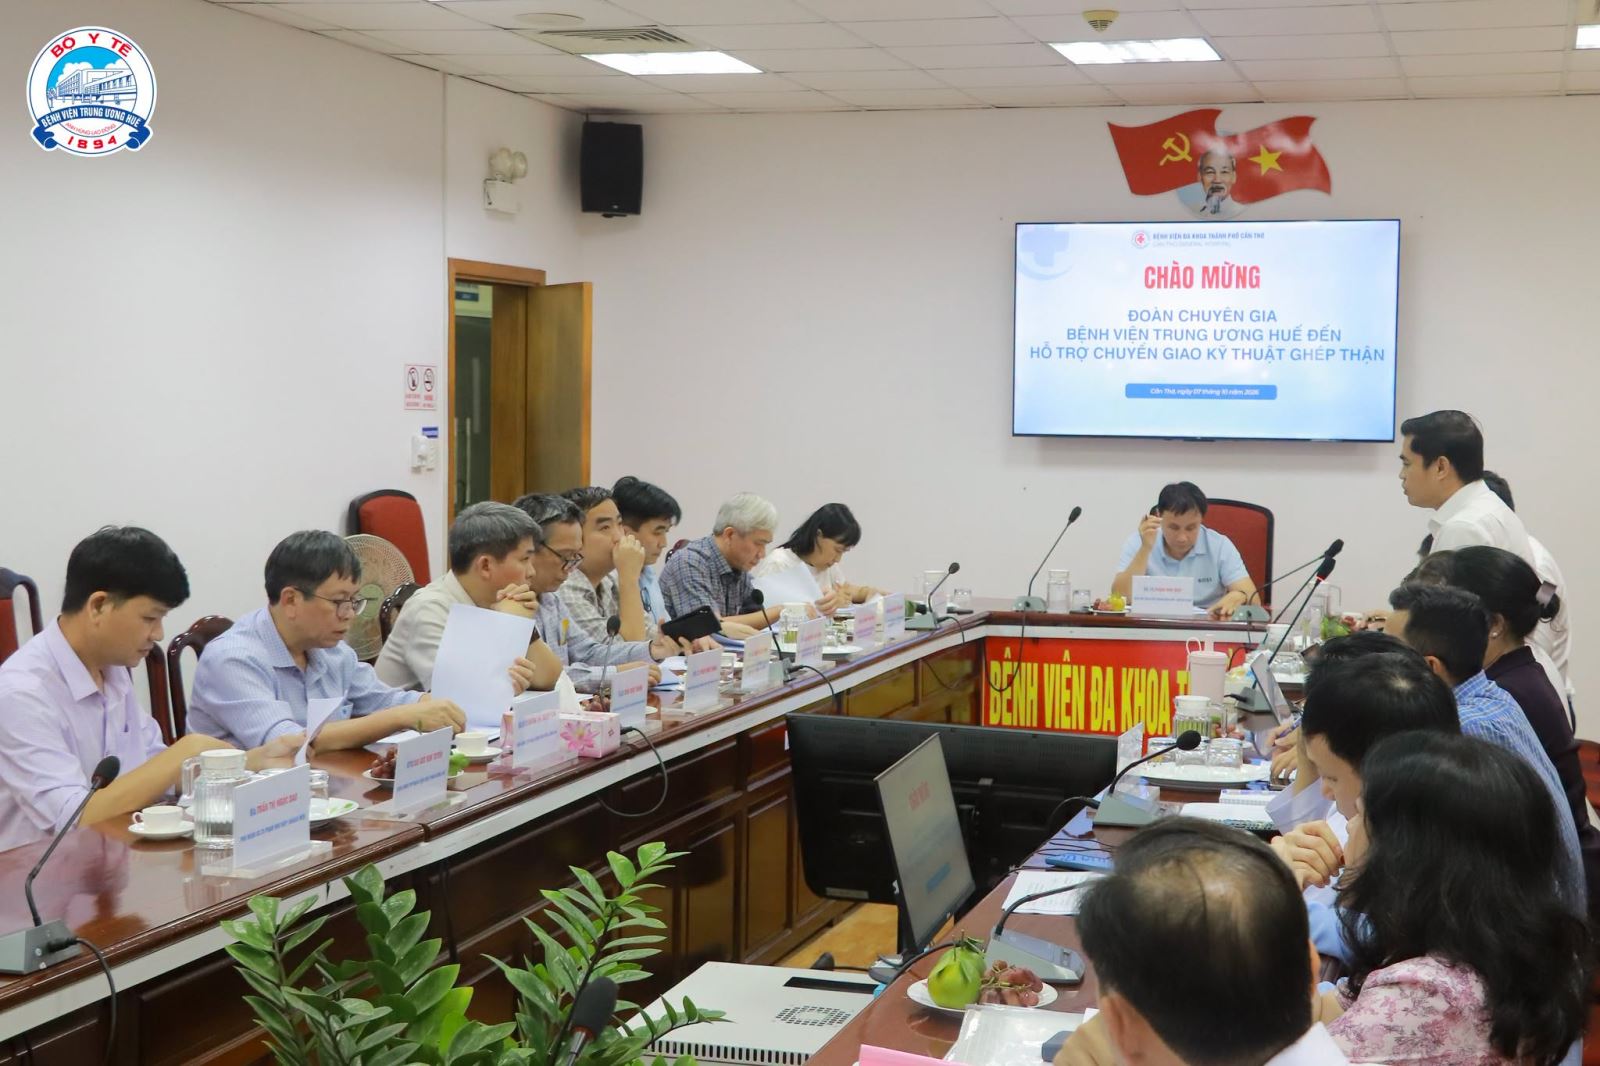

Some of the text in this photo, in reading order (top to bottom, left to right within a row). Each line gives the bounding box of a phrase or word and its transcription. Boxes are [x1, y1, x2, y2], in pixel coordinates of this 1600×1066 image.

[1144, 260, 1261, 289] CHÀO MỪNG
[1128, 306, 1278, 322] ĐOÀN CHUYÊN GIA
[1066, 324, 1342, 344] BỆNH VIỆN TRUNG ƯƠNG HUẾ ĐẾN
[1030, 341, 1053, 359] HỖ
[1056, 346, 1089, 363] TRỢ
[1162, 347, 1202, 360] GIAO
[1207, 344, 1230, 361] KỸ
[1231, 345, 1286, 364] THUẬT
[1290, 344, 1336, 361] GHÉP
[1339, 345, 1385, 365] THẬN
[1121, 667, 1171, 735] KHOA
